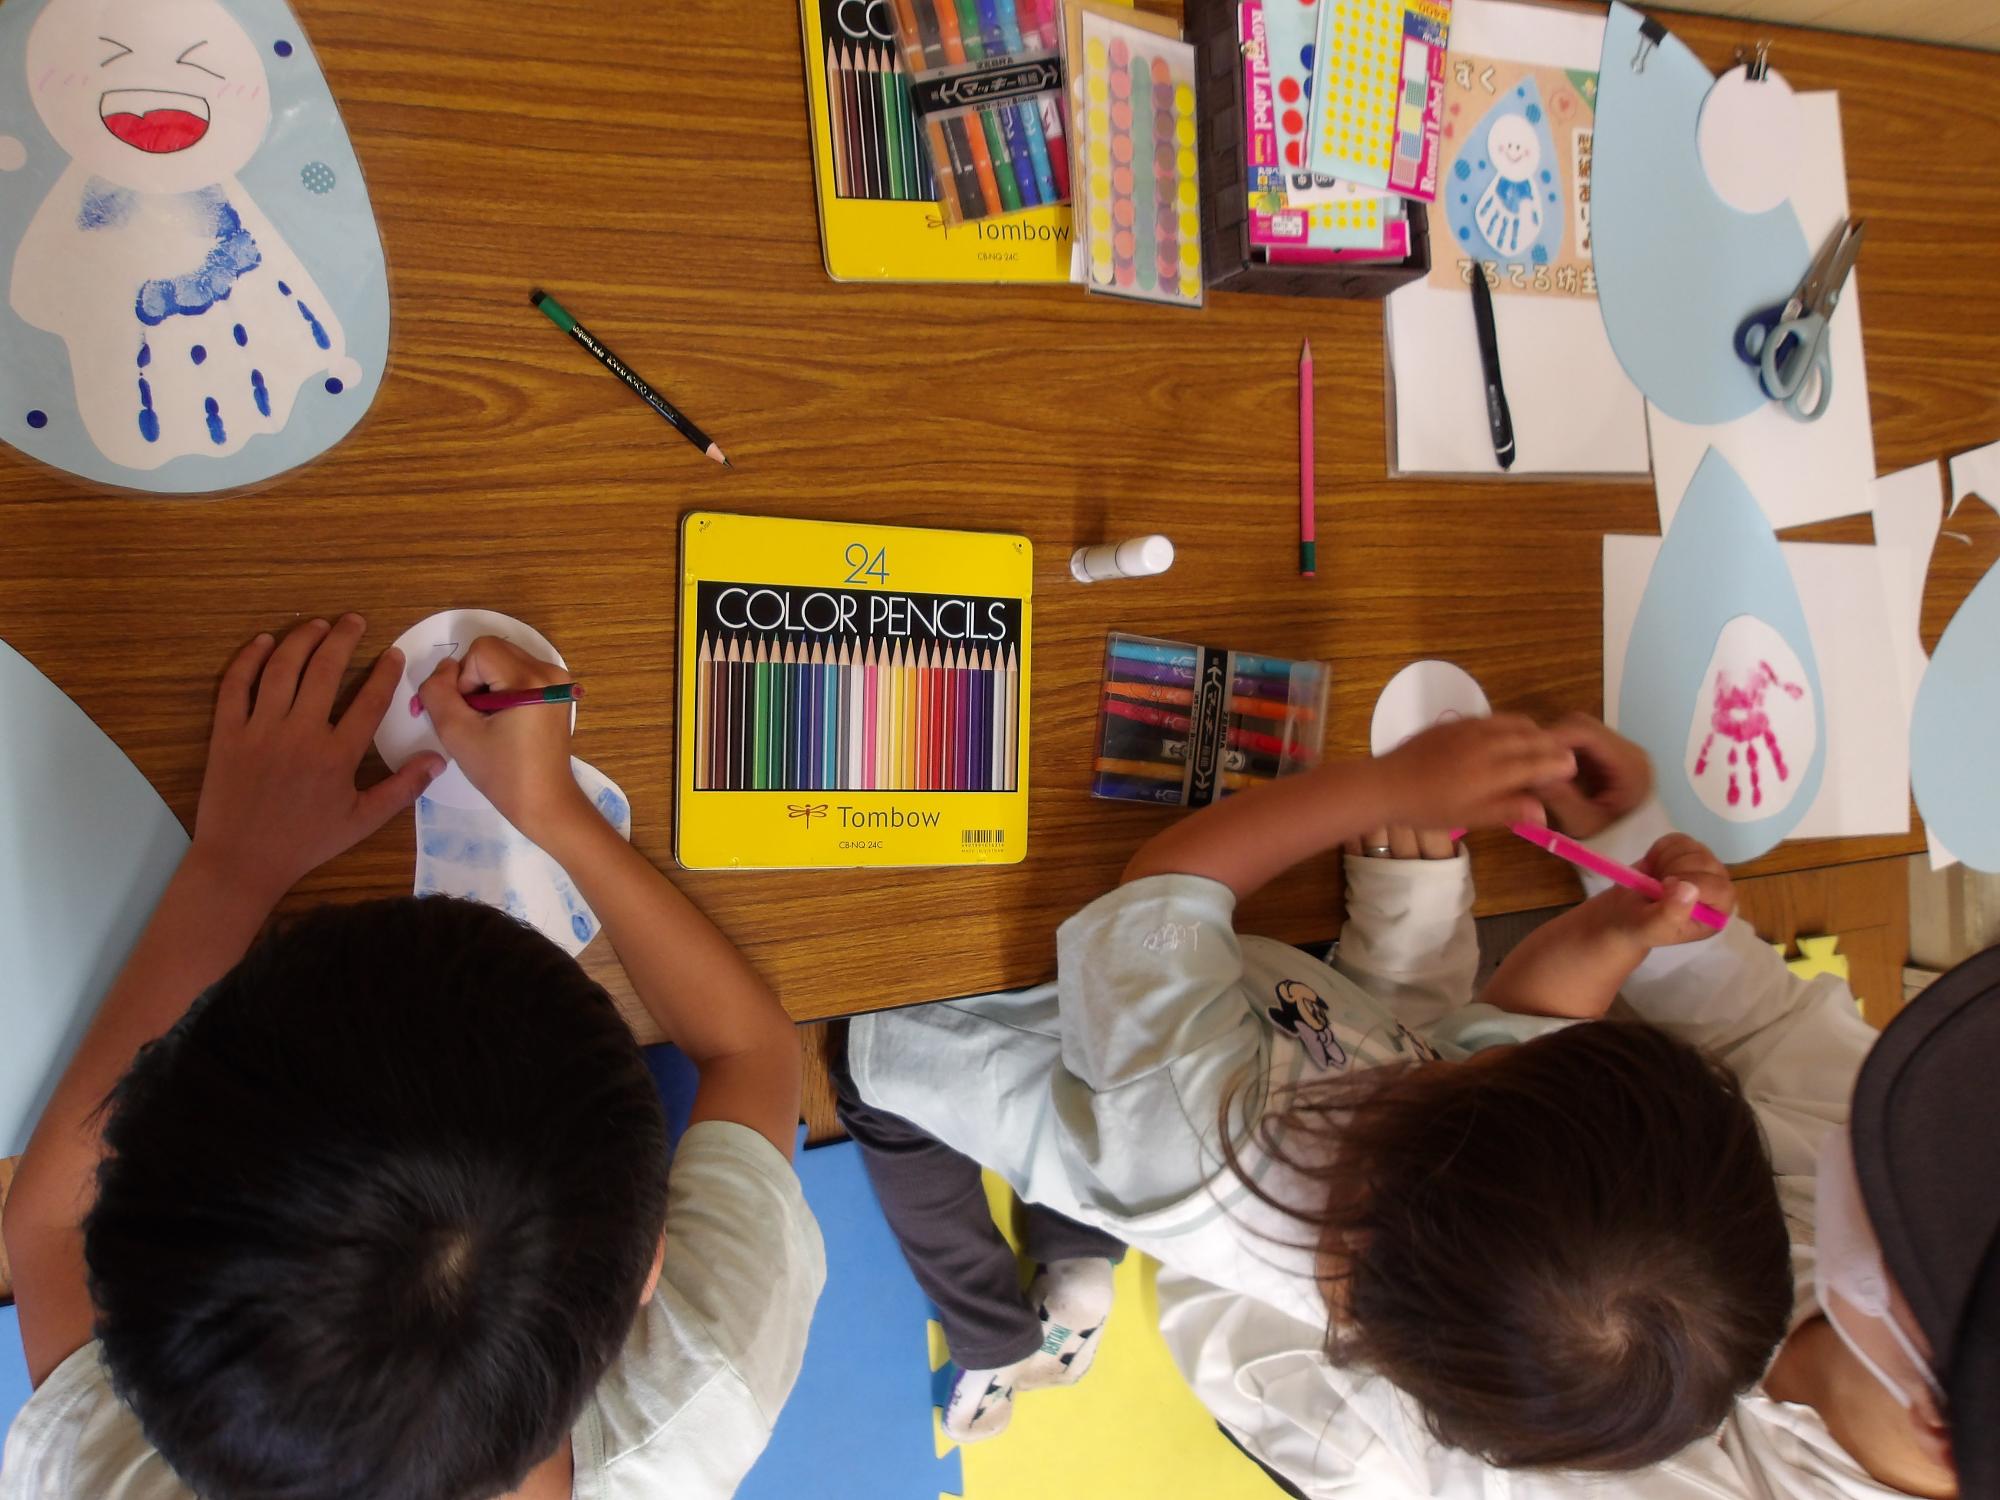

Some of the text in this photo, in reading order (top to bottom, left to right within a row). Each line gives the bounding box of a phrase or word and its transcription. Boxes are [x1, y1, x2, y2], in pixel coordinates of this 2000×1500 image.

[1253, 78, 1272, 131] Label
[1425, 79, 1444, 131] Label
[1420, 132, 1439, 193] Round
[844, 543, 890, 585] 24
[716, 587, 1006, 640] COLOR PENCILS
[837, 805, 941, 828] Tombow
[868, 840, 883, 849] 24C
